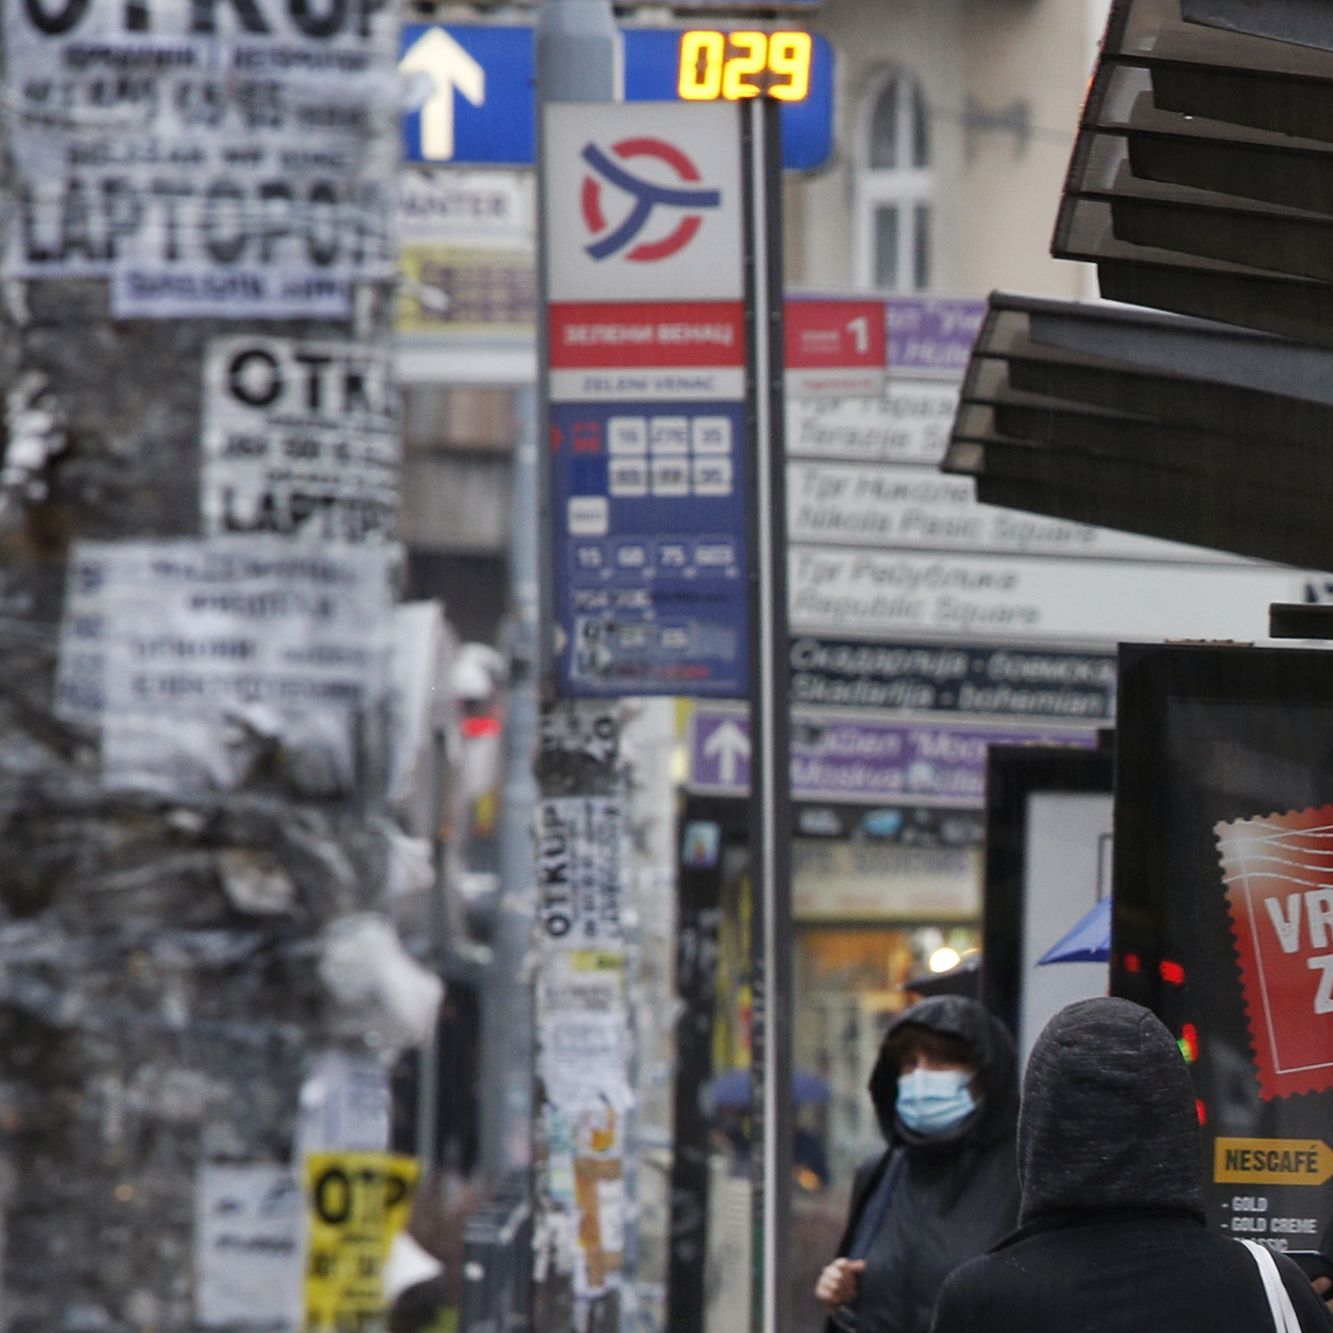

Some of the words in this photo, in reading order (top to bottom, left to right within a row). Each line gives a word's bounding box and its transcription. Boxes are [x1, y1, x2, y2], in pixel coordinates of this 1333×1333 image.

[678, 30, 812, 101] 029
[563, 322, 652, 347] ЗЕЛЕНИ
[656, 322, 735, 348] ВЕНАЦ
[847, 316, 869, 353] 1
[934, 593, 1041, 627] Square
[1225, 1144, 1320, 1174] NESCAFÉ
[1231, 1196, 1268, 1212] GOLD
[1231, 1217, 1267, 1232] GOLD
